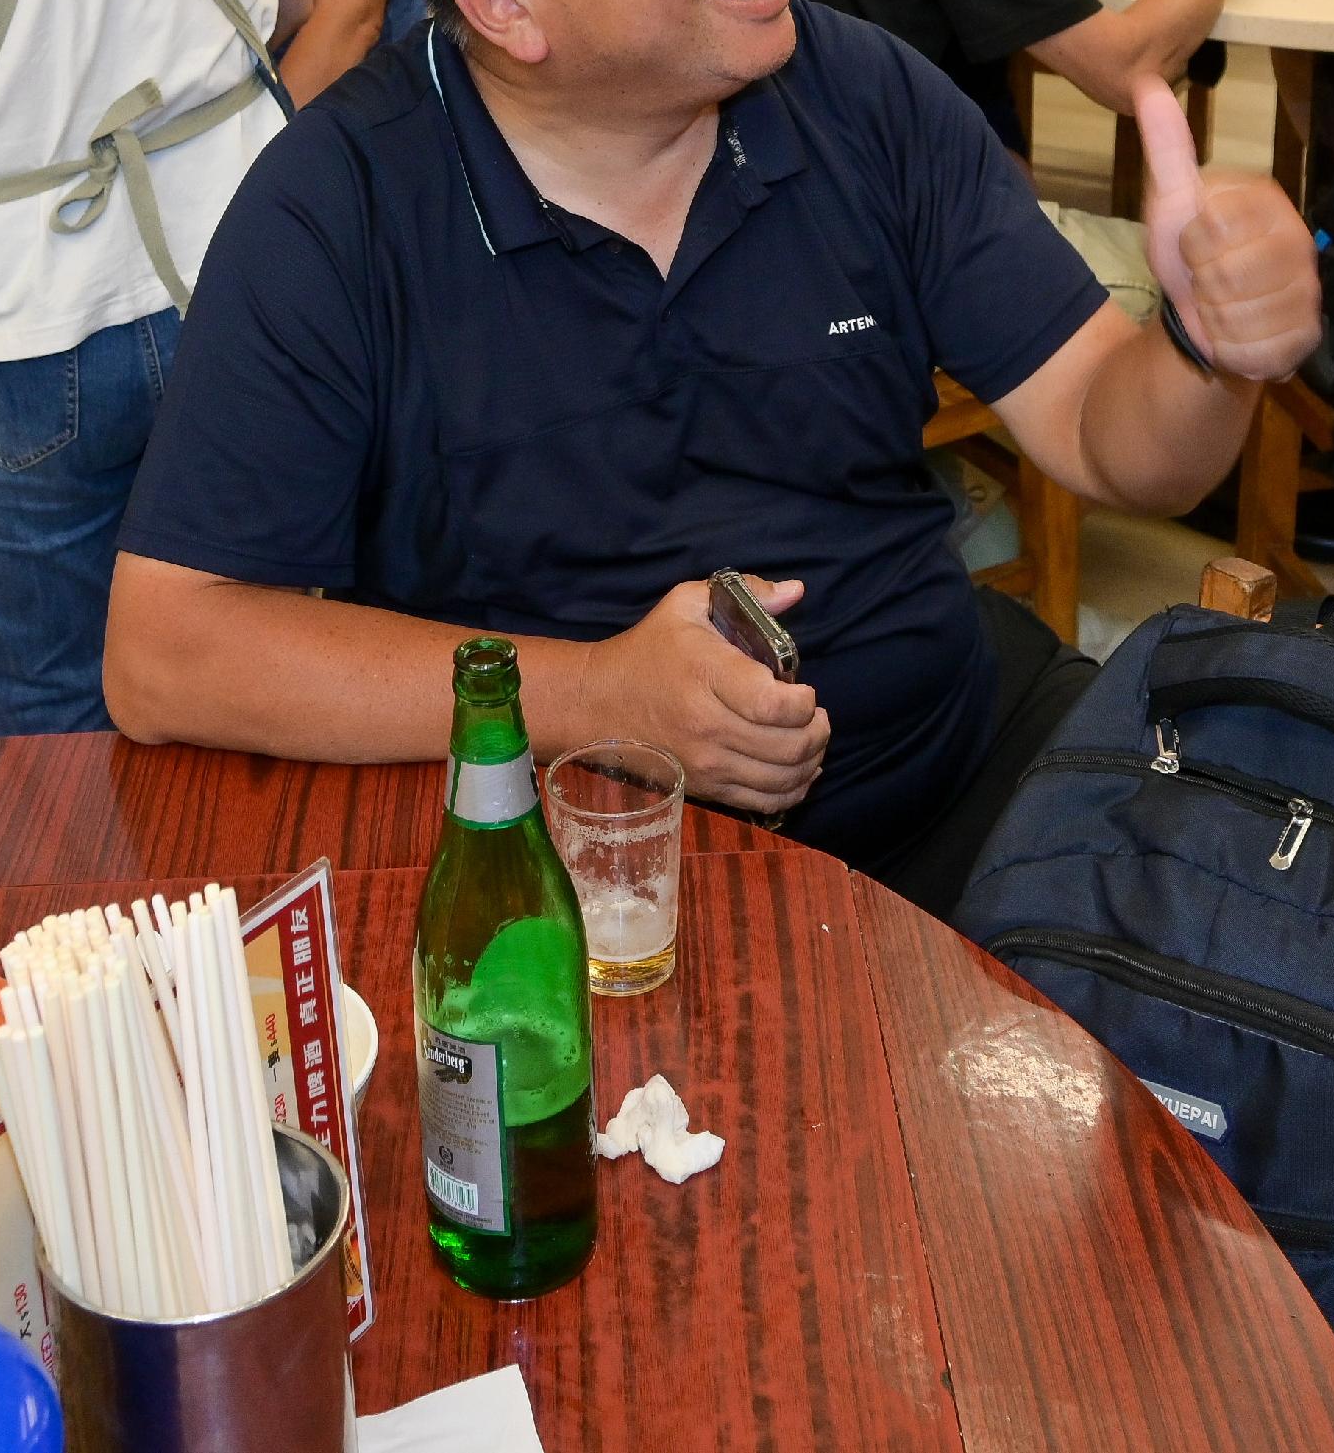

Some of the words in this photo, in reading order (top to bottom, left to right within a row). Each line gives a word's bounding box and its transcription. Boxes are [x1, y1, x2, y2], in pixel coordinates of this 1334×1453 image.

[828, 315, 877, 335] ARTEN
[291, 905, 318, 1027] 真正朋友
